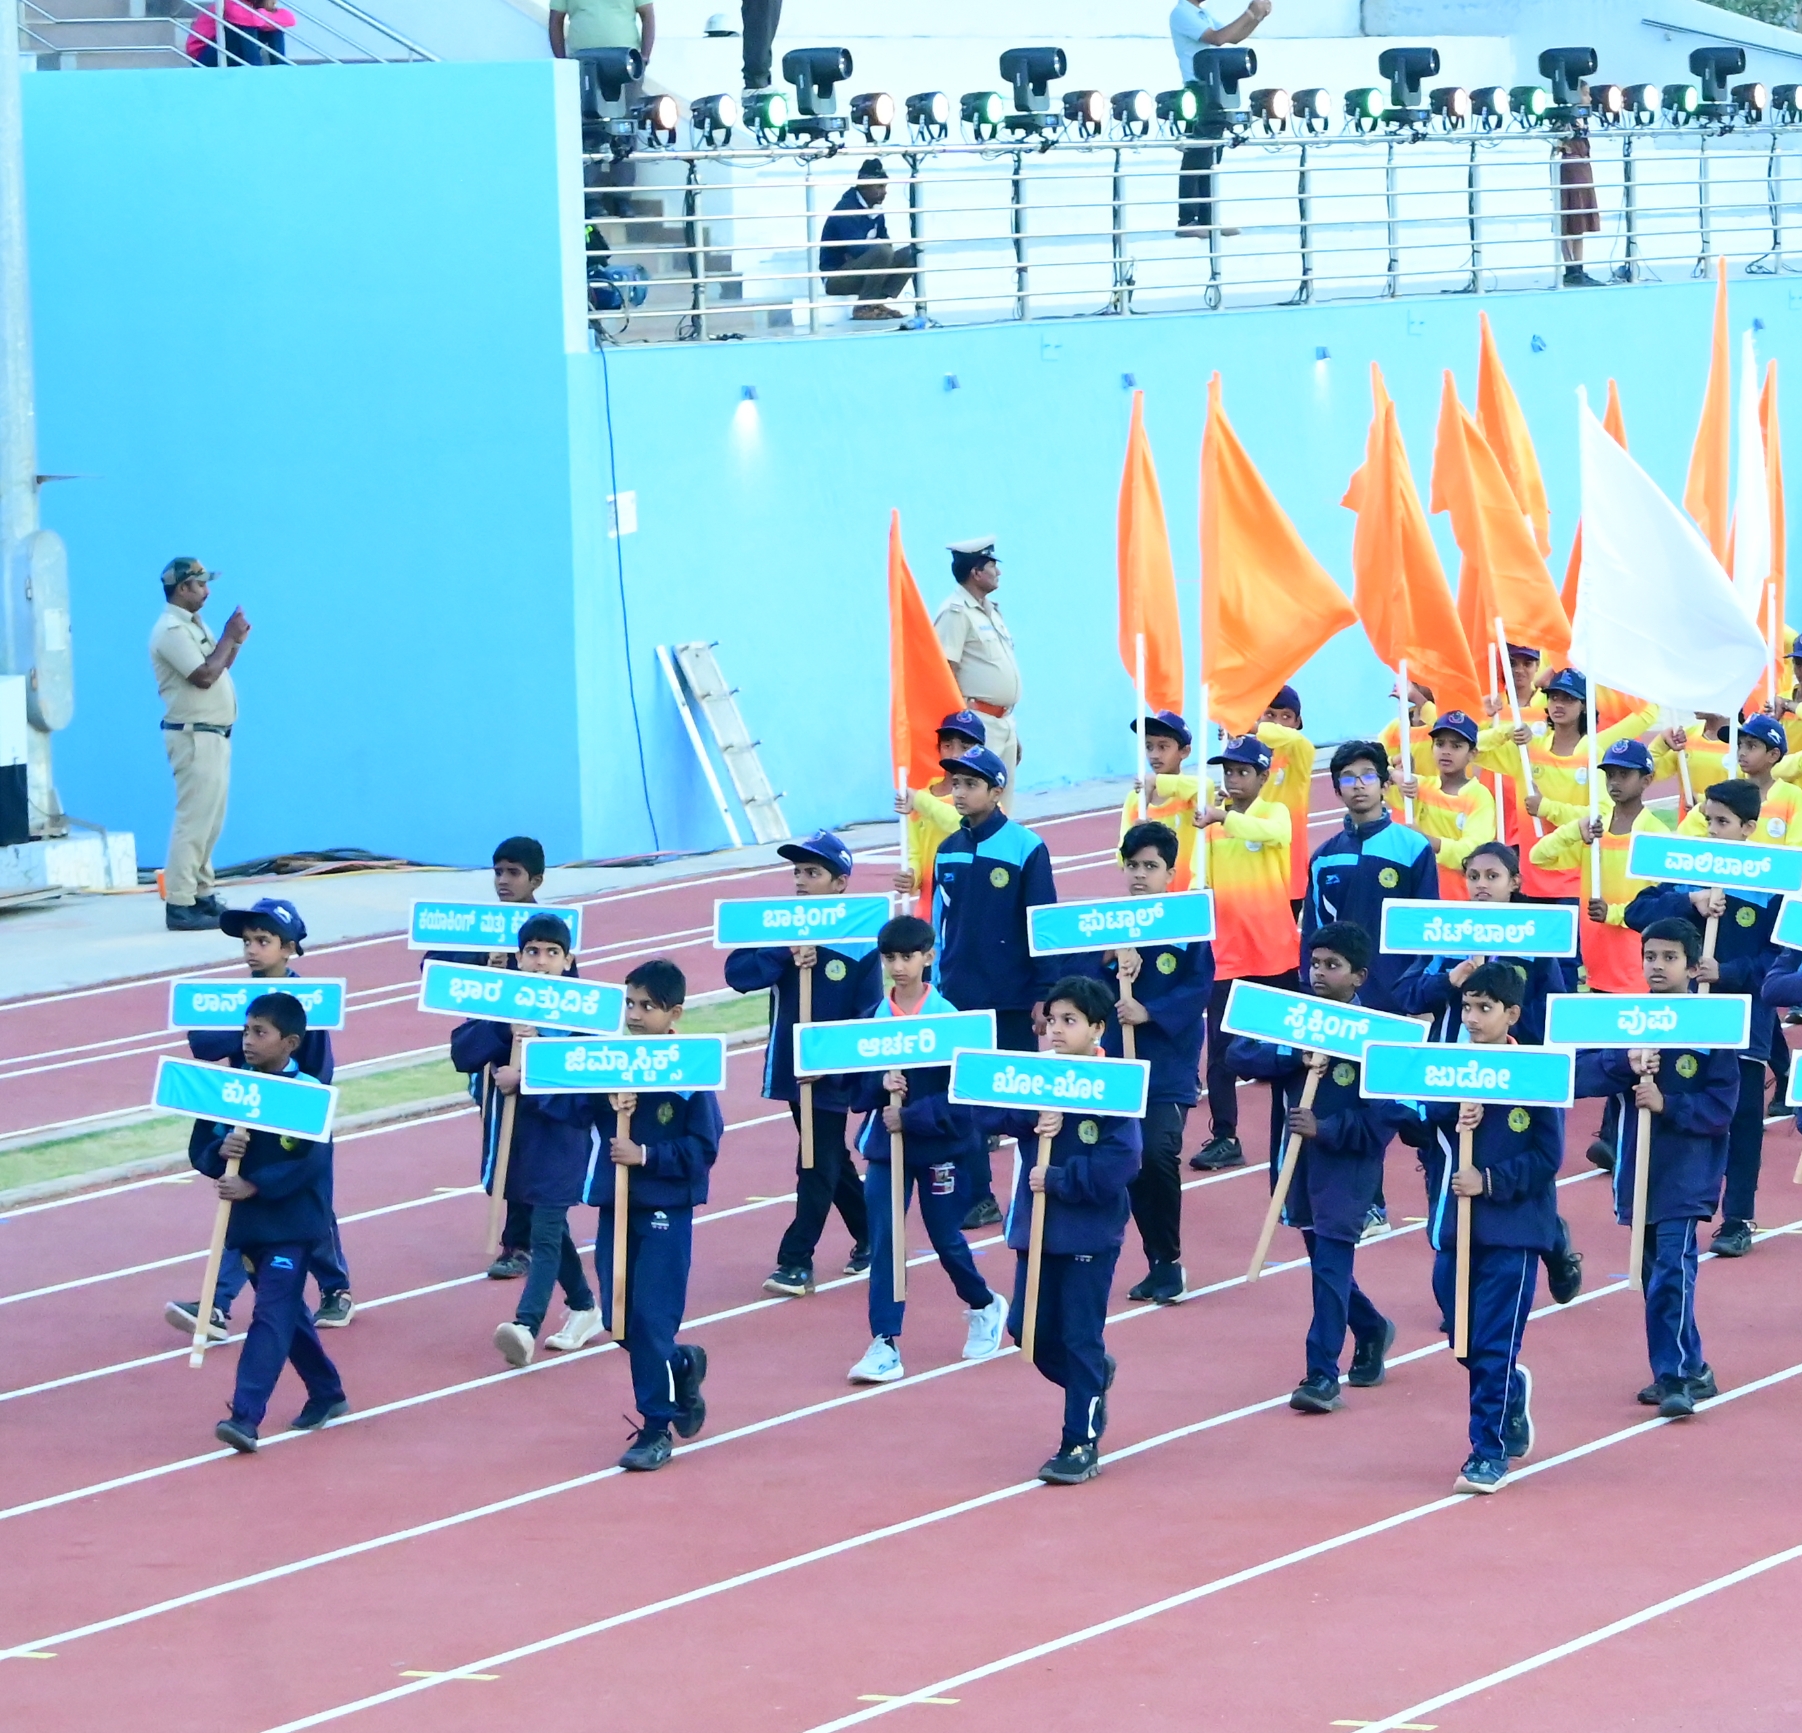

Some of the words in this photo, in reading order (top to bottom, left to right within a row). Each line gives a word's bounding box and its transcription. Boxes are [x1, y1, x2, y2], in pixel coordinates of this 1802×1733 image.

[1663, 849, 1774, 879] ವಾಲಿಬಾಲ್
[479, 911, 507, 943] ಮತ್ತು
[762, 901, 847, 937] ಬಾಕ್ಸಿಂಗ್
[192, 987, 248, 1012] ಲಾನ್
[449, 976, 503, 1010] ಭಾರ
[514, 984, 601, 1019] ಎತ್ತುವಿಕೆ
[1282, 1001, 1371, 1044] ಸೈಕ್ಲಿಂಗ್
[1616, 1004, 1679, 1036] ವುಷು
[857, 1027, 937, 1058] ಆರ್ಚರಿ
[563, 1044, 684, 1080] ಜಿಮ್ನಾಸ್ಟಿಕ್ಸ್
[1424, 1058, 1512, 1091] ಜುಡೋ
[221, 1079, 263, 1119] ಕುಸ್ತಿ
[990, 1065, 1107, 1101] ಖೋ-ಖೋ
